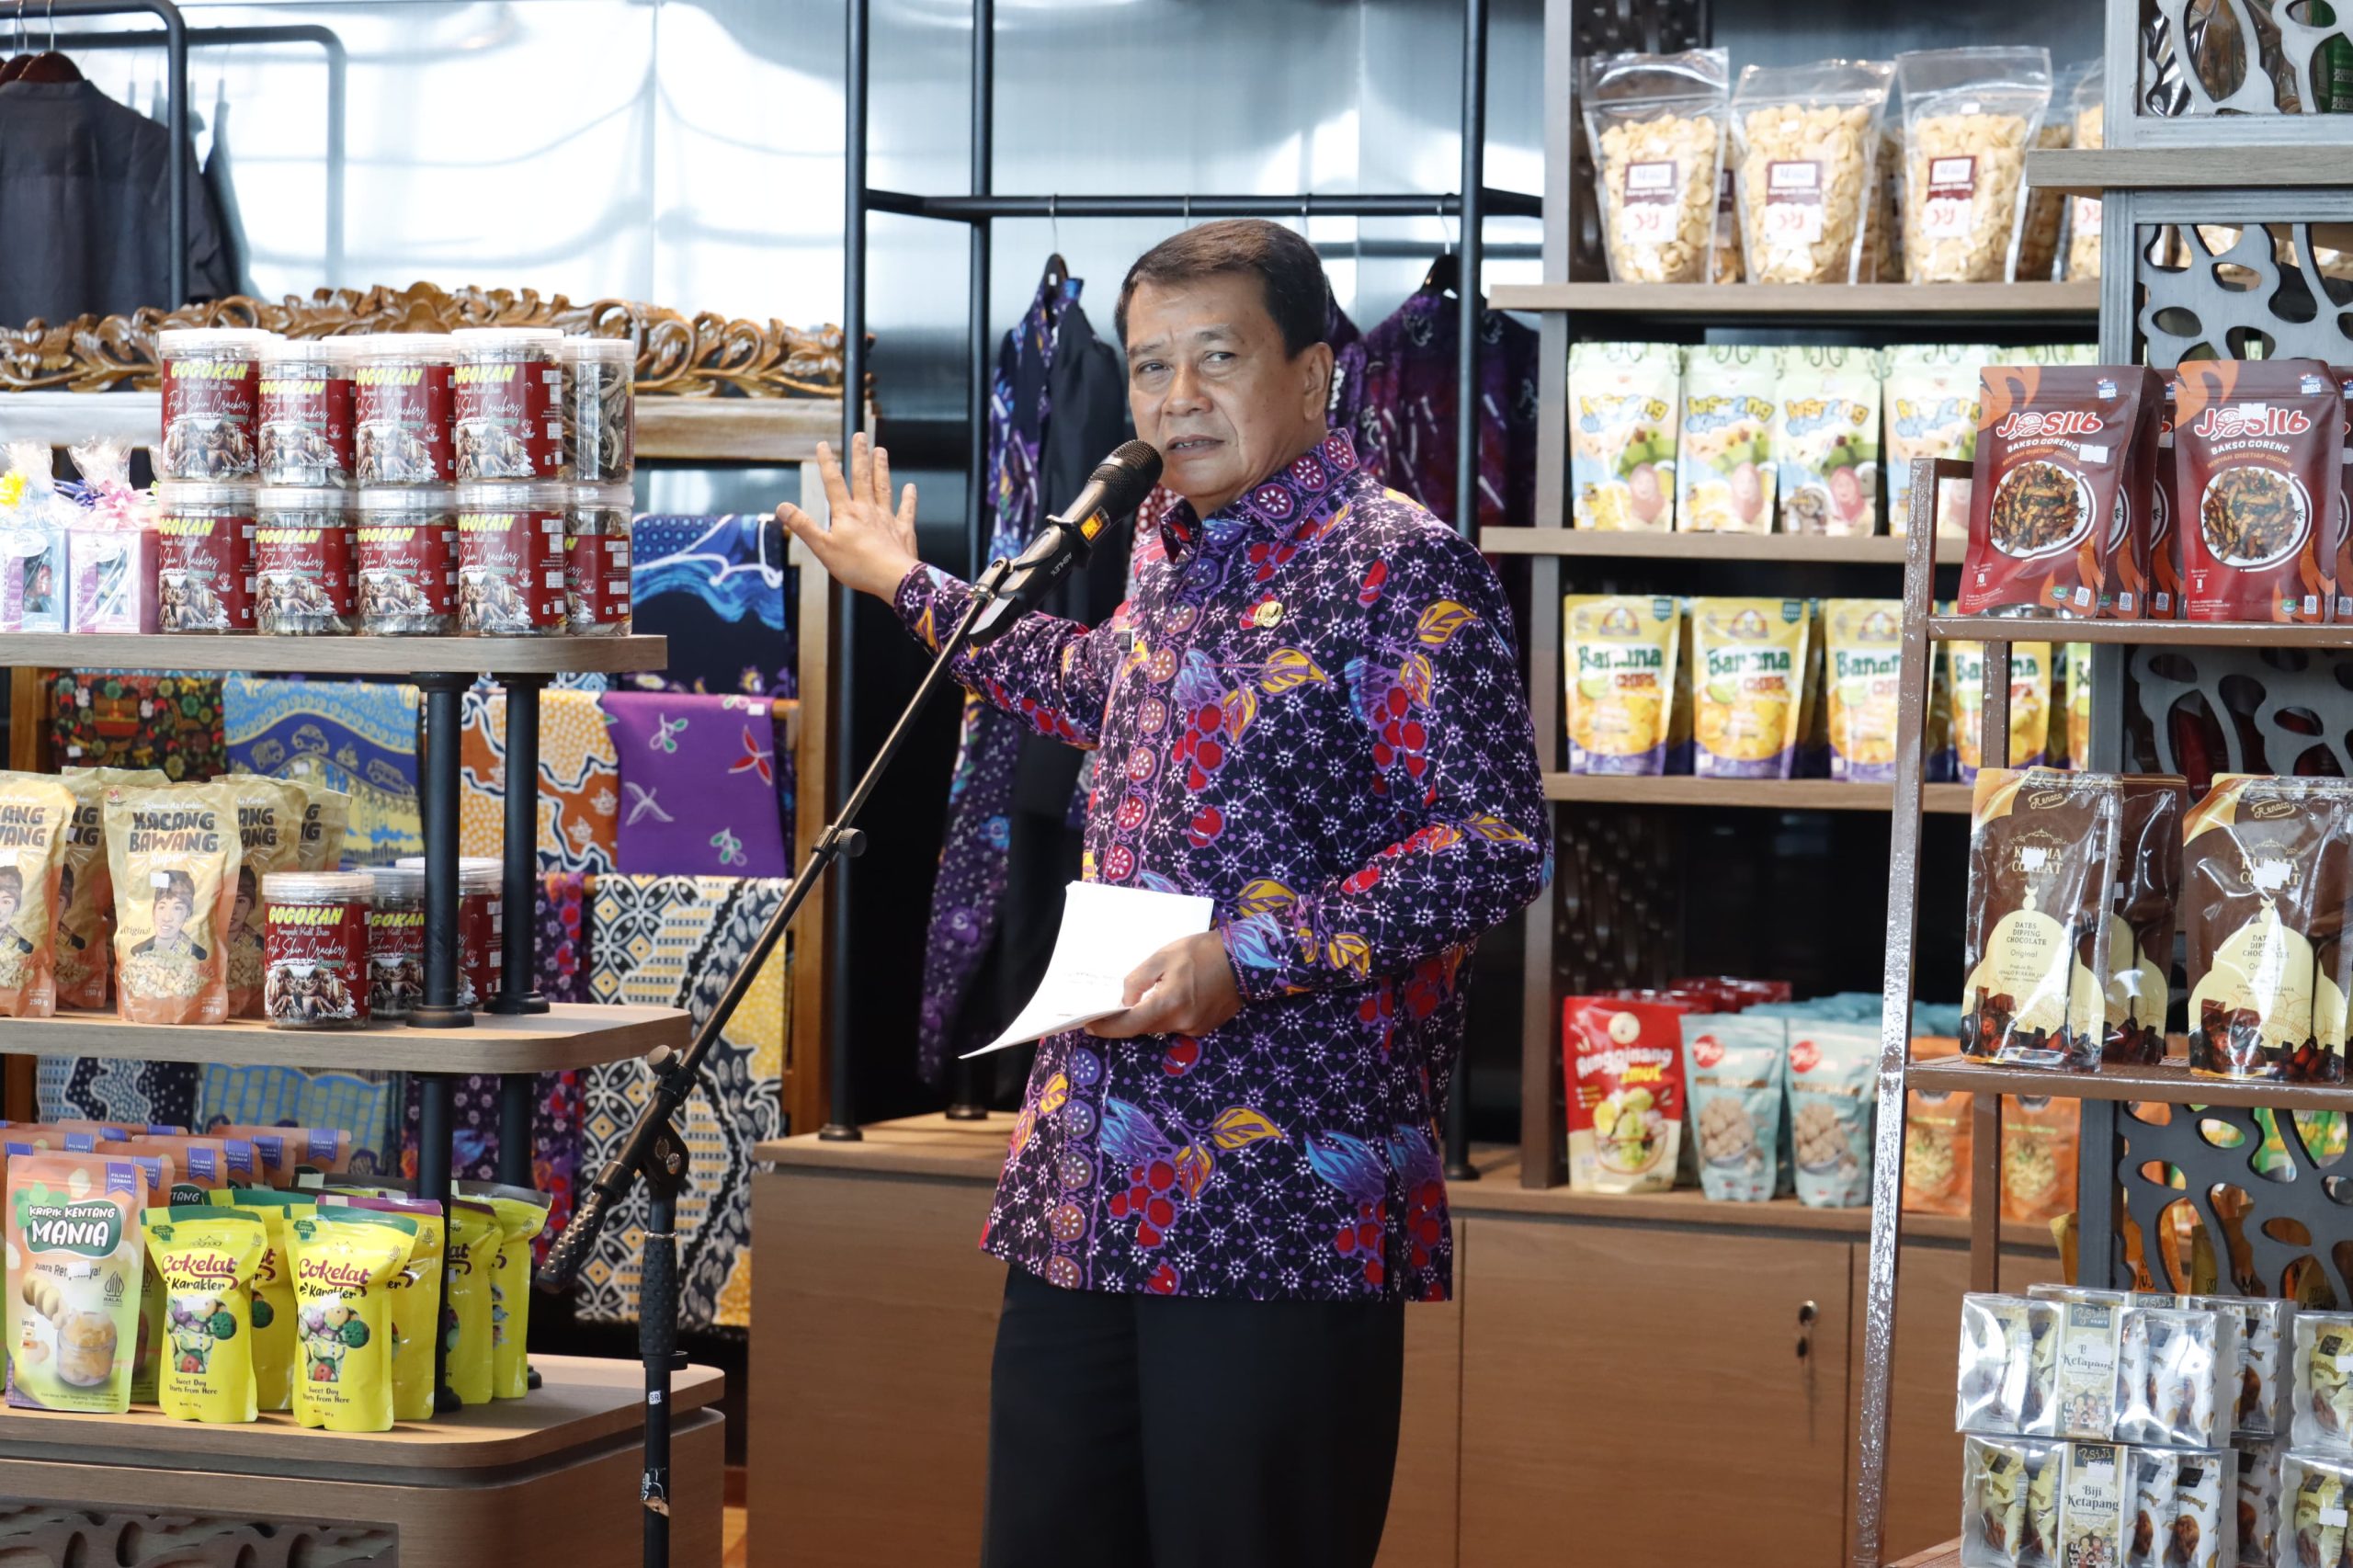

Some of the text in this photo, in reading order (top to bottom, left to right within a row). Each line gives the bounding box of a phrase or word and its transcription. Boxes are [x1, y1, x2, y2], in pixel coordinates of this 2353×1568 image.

[171, 361, 248, 381] GOGOKAN
[212, 392, 252, 414] Crackers
[385, 397, 426, 420] Crackers
[480, 395, 522, 416] Crackers
[288, 405, 330, 422] Crackers
[2006, 437, 2080, 453] BAKSO GORENG
[2211, 440, 2290, 456] BAKSO GORENG
[179, 546, 220, 570] Crackers
[284, 551, 325, 572] Crackers
[380, 551, 421, 569] Crackers
[478, 544, 520, 566] Crackers
[2030, 792, 2063, 810] Renaco
[2254, 801, 2290, 819] Renaco
[0, 805, 46, 825] ANG
[132, 812, 216, 831] KACANG
[129, 832, 220, 853] BAWANG
[150, 852, 188, 867] Super
[268, 905, 345, 926] GOGOKAN
[2012, 929, 2040, 937] DIPPING
[2015, 921, 2037, 929] DATES
[267, 935, 348, 962] Fish Skin Crackers
[2006, 937, 2047, 946] CHOCOLATE
[2010, 949, 2038, 959] Original
[170, 1192, 199, 1202] TANG
[28, 1206, 117, 1219] KRIPIK KENTANG
[31, 1220, 109, 1247] MANIA
[162, 1254, 238, 1280] Cokelat
[299, 1258, 371, 1289] Cokelat
[172, 1278, 225, 1290] Karakter
[176, 1377, 207, 1388] Sweet Day
[184, 1386, 199, 1394] From
[201, 1386, 218, 1395] Here
[308, 1386, 339, 1397] Sweet Day
[2082, 1484, 2102, 1497] Biji
[2065, 1494, 2120, 1513] Ketapang
